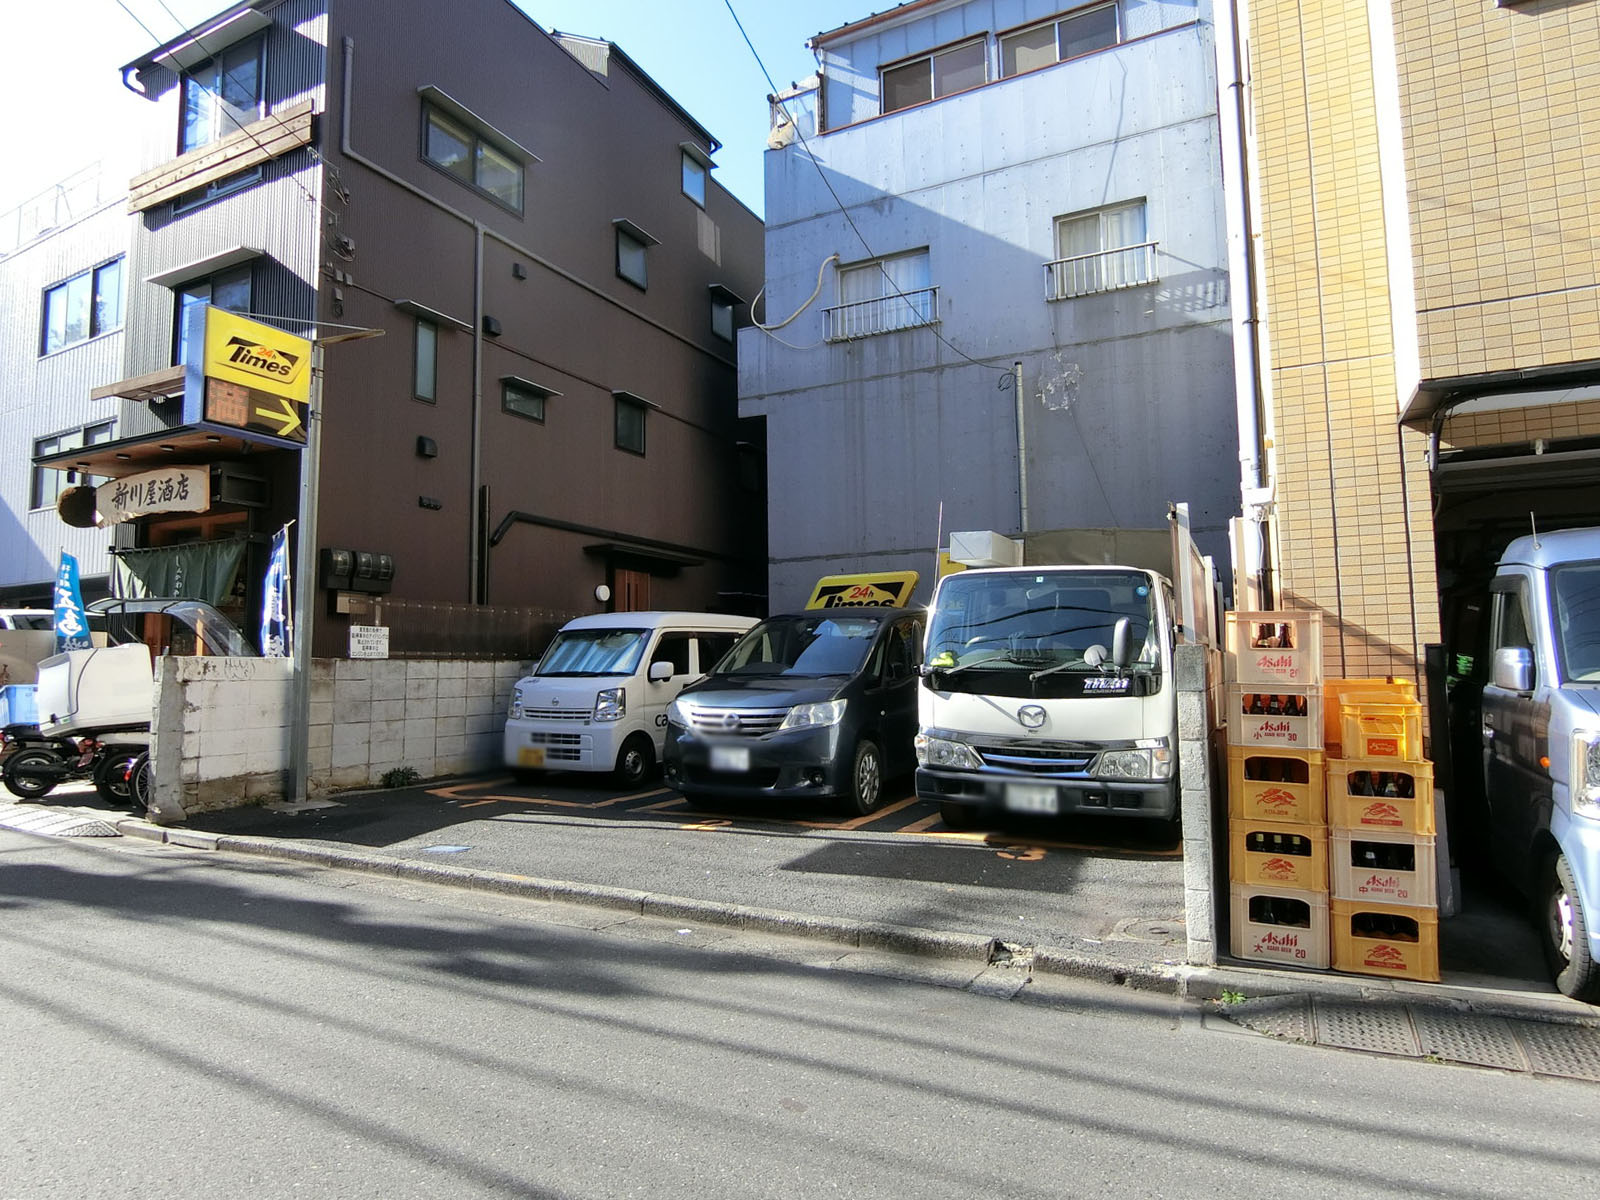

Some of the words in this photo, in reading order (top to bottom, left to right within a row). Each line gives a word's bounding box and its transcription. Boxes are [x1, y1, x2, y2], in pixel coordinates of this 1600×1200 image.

[229, 345, 292, 376] Times
[111, 473, 189, 510] 新川屋酒店
[849, 586, 874, 599] 24h
[1256, 655, 1292, 667] Asahi
[1260, 720, 1290, 732] Asahi
[1288, 733, 1297, 741] 30
[1366, 874, 1400, 887] Asahi
[1359, 886, 1368, 894] 中
[1398, 889, 1408, 898] 20
[1261, 931, 1298, 947] Asahi
[1254, 943, 1263, 953] 大
[1295, 949, 1306, 959] 20
